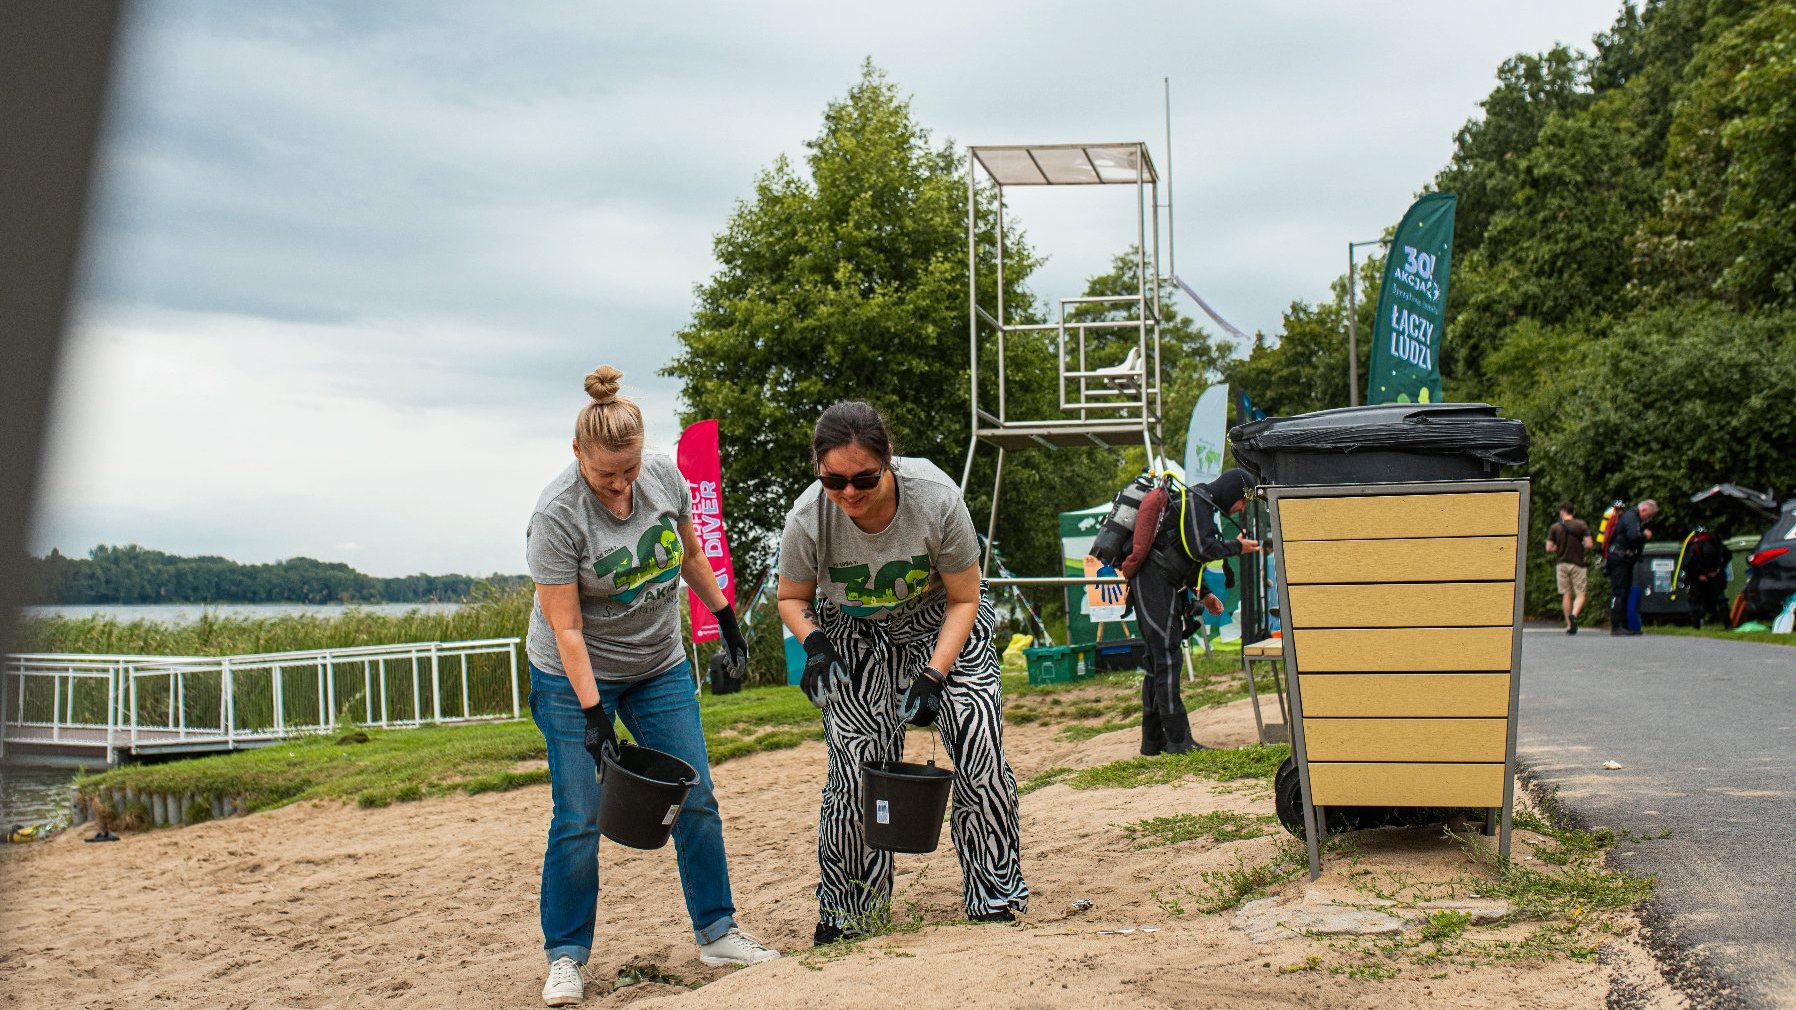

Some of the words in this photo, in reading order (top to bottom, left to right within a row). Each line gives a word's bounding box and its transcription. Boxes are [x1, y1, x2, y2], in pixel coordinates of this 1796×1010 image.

[1393, 266, 1427, 293] AKCJA
[1404, 244, 1437, 281] 30!
[1391, 303, 1434, 346] ŁĄCZY
[1390, 332, 1432, 371] LUDZI
[700, 480, 724, 558] DIVER
